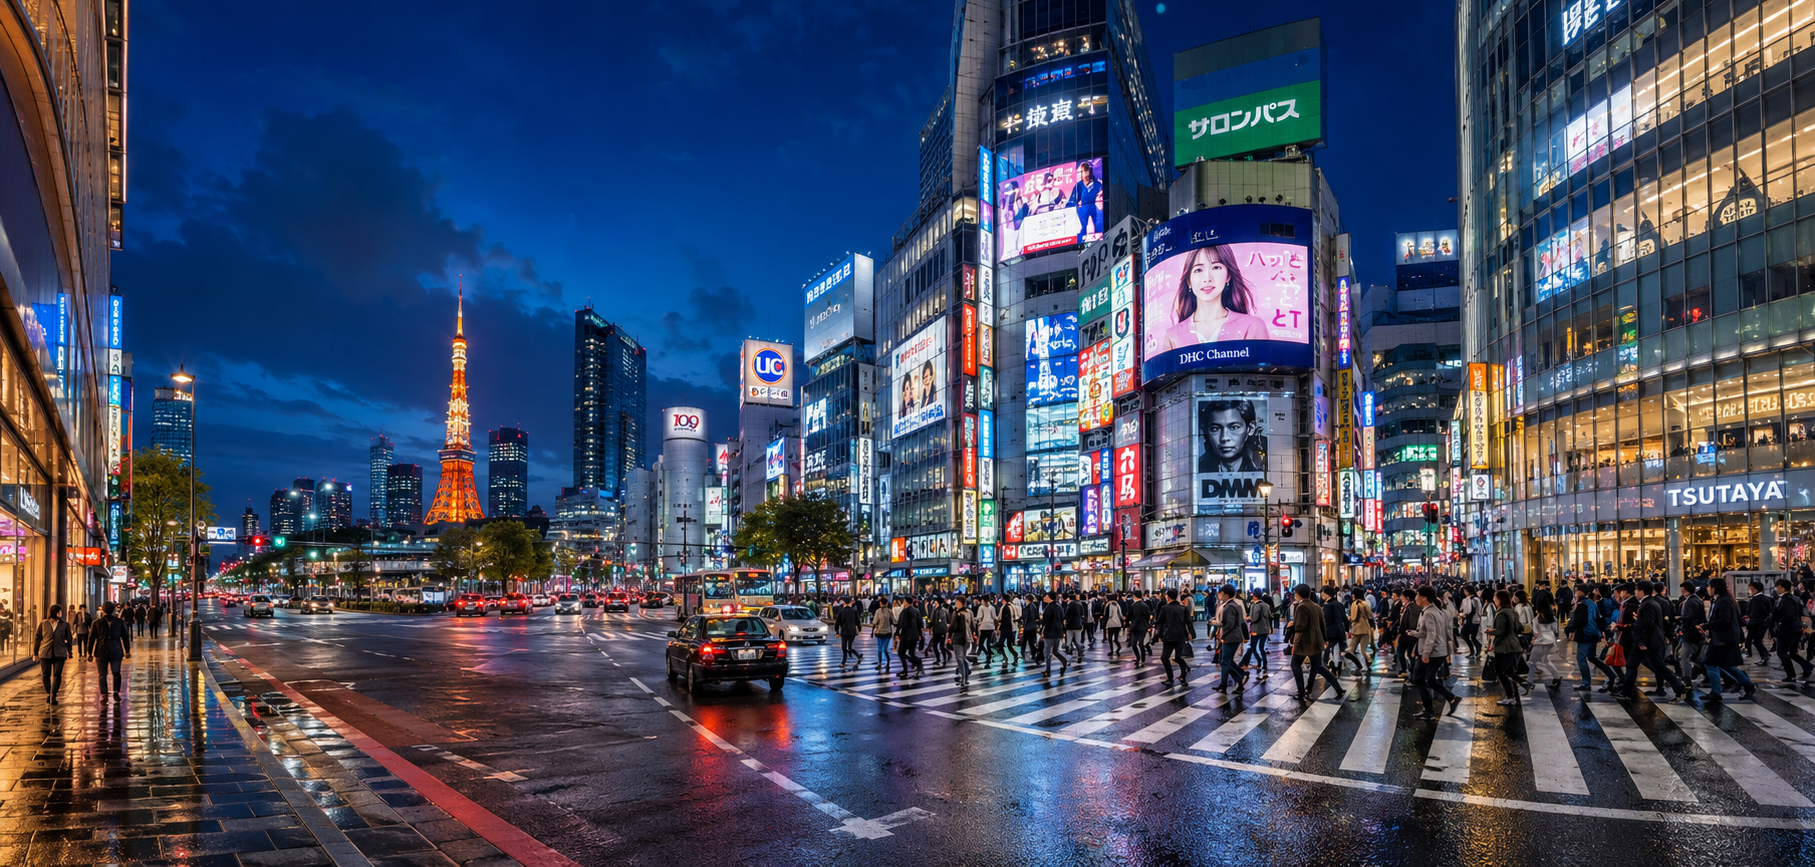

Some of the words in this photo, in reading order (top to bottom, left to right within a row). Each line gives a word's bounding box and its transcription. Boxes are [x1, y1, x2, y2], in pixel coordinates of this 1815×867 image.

[1188, 98, 1300, 140] サロンパス
[1179, 350, 1204, 365] DHC
[1206, 347, 1250, 359] Channel
[673, 414, 700, 430] 109
[1201, 477, 1266, 499] DMM
[1667, 480, 1785, 507] TSUTAYA
